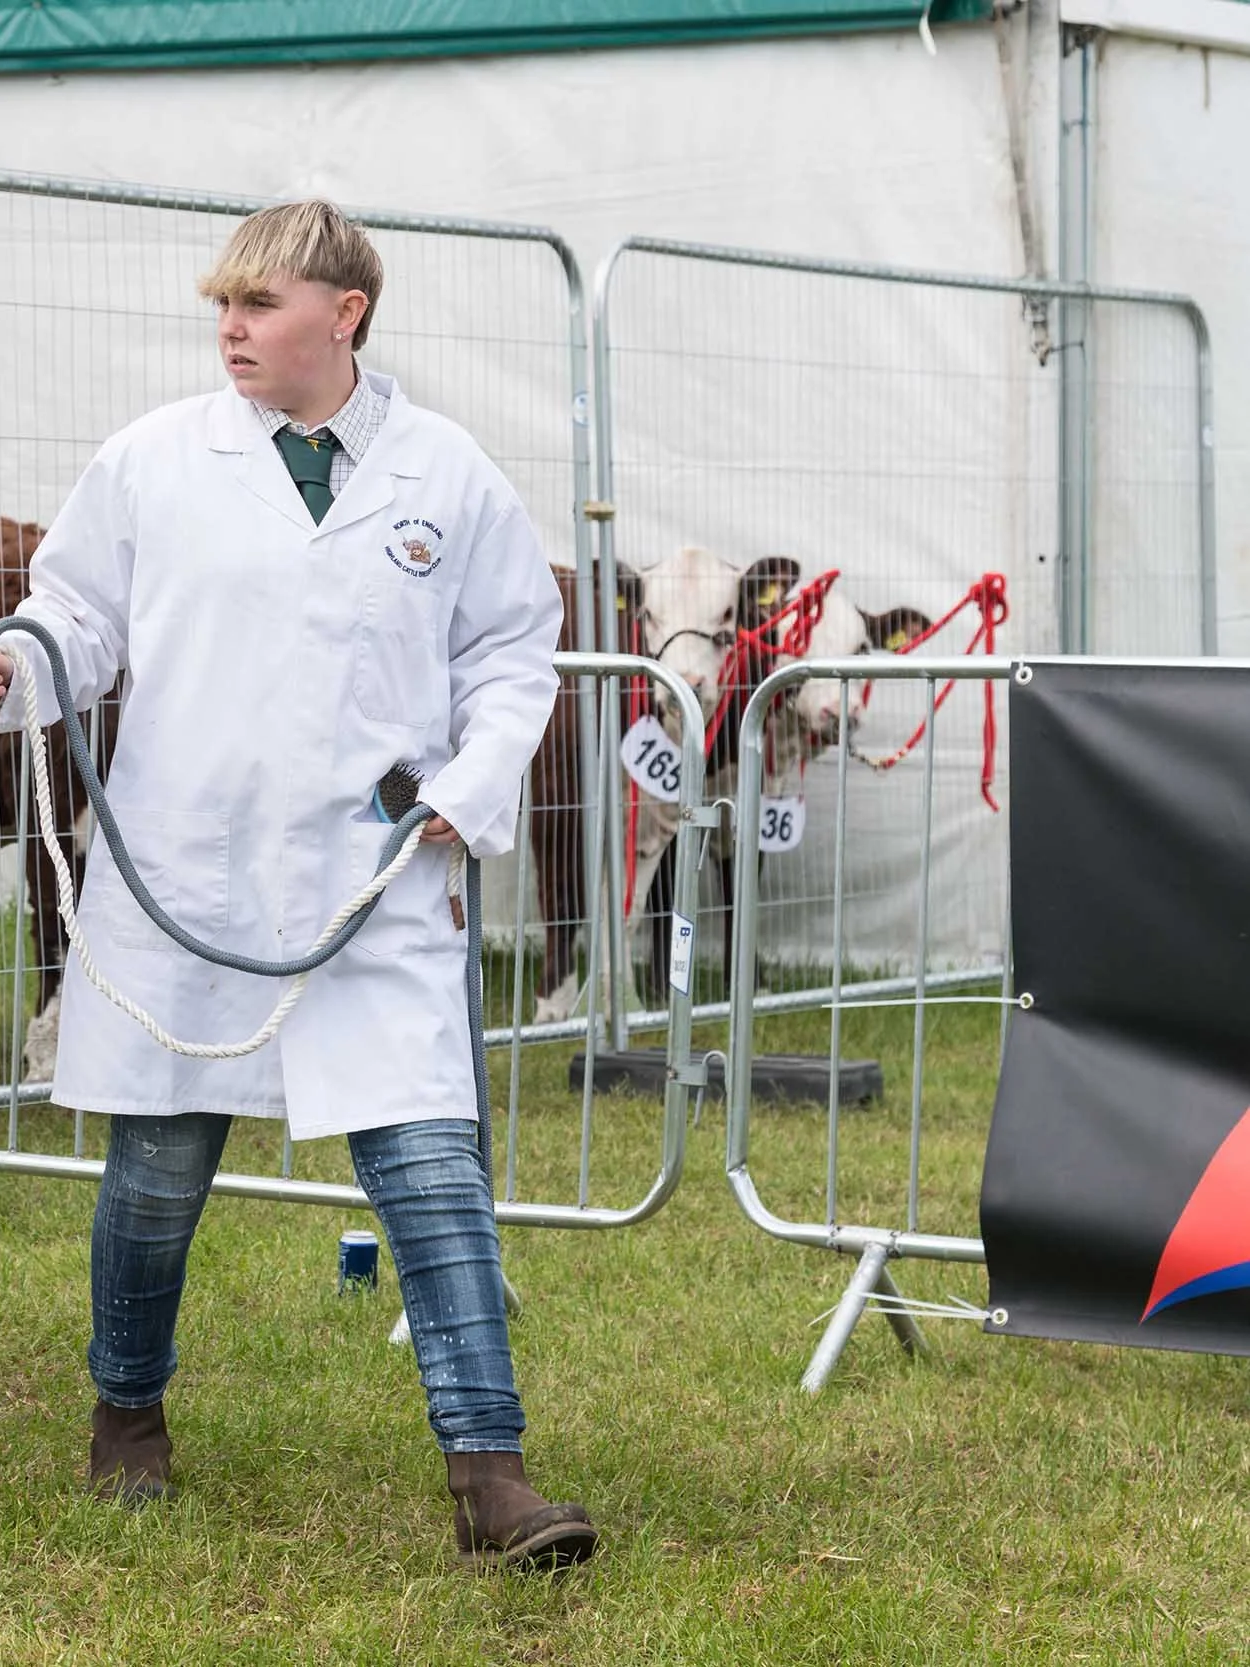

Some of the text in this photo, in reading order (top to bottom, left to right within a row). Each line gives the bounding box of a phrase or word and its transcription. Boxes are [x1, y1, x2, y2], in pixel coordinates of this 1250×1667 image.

[393, 519, 411, 531] NORTH
[422, 519, 443, 540] ENGLAND
[384, 545, 403, 568] HIGHLAND
[402, 565, 418, 577] CATTLE
[761, 808, 794, 841] 36
